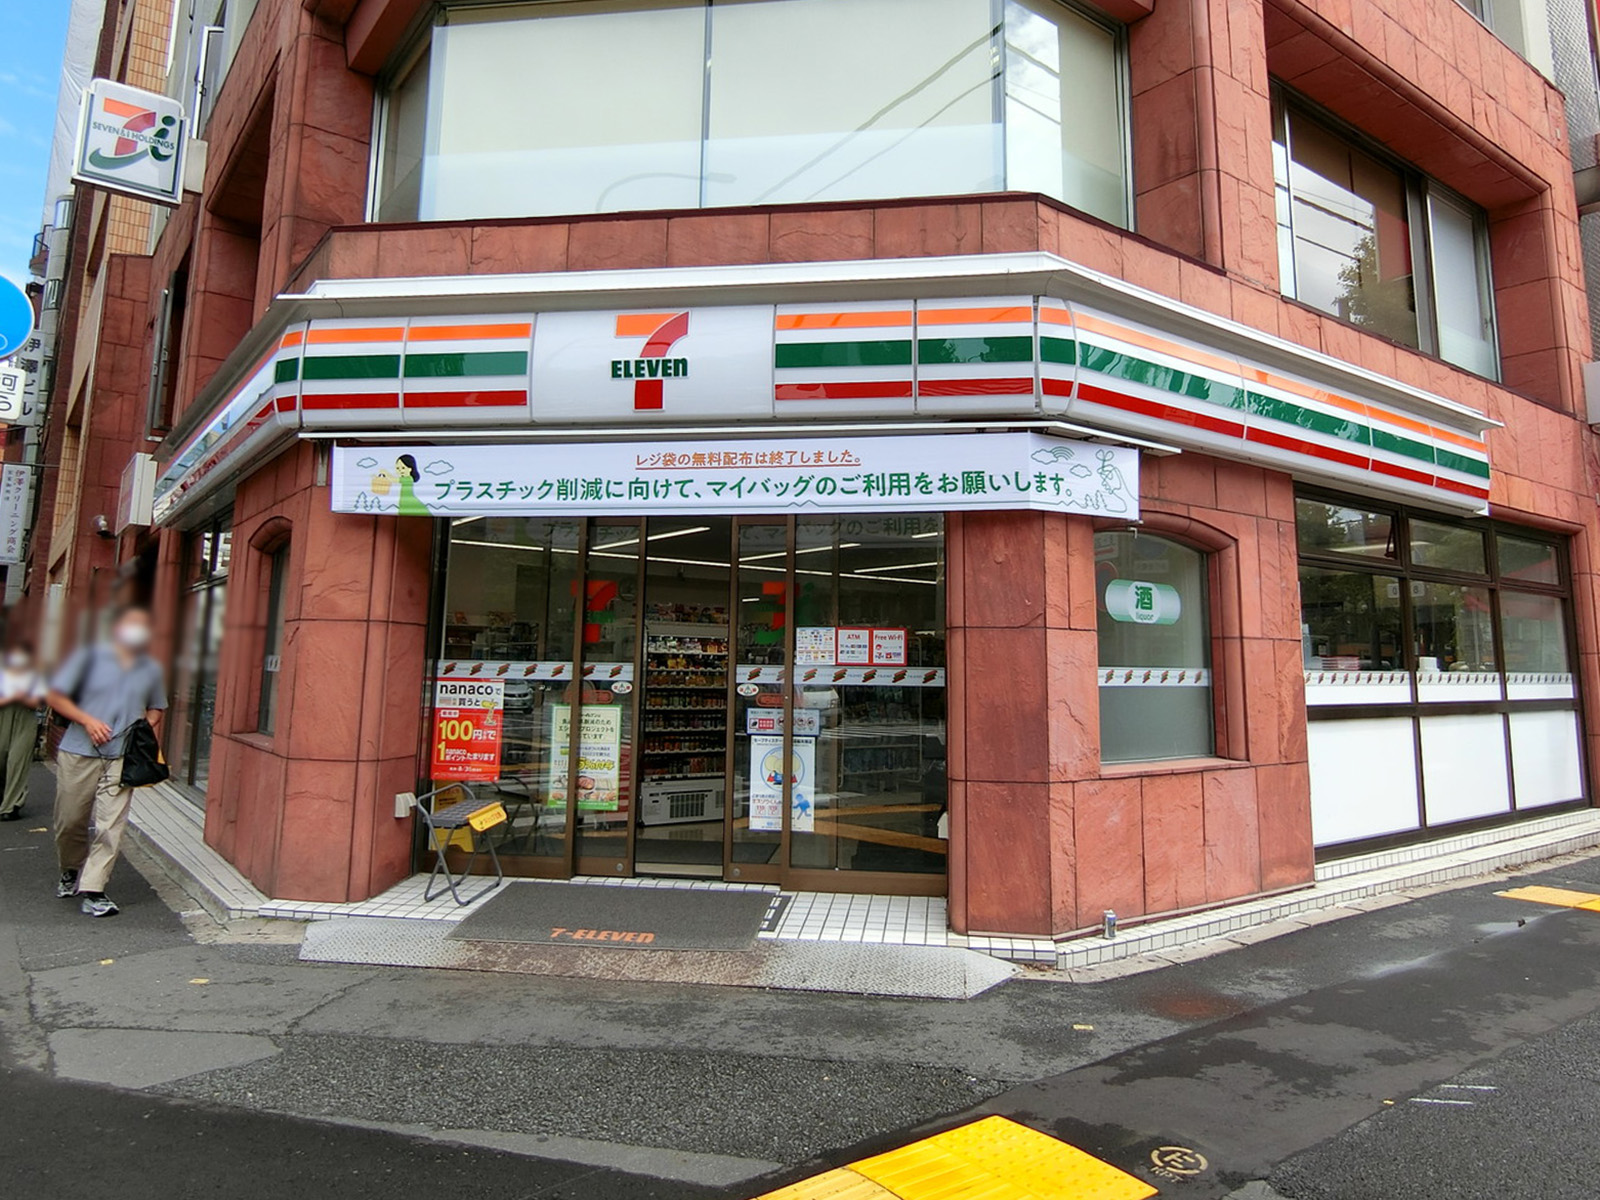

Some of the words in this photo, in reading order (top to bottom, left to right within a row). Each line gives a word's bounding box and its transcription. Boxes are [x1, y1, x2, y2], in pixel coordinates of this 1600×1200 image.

[131, 132, 175, 150] HOLDINGS
[636, 449, 861, 467] レジ袋の無料配布は終了しました。
[434, 470, 1073, 501] プラスチック削減に向けて、マイバッグのご利用をお願いします。
[1135, 585, 1153, 610] 酒
